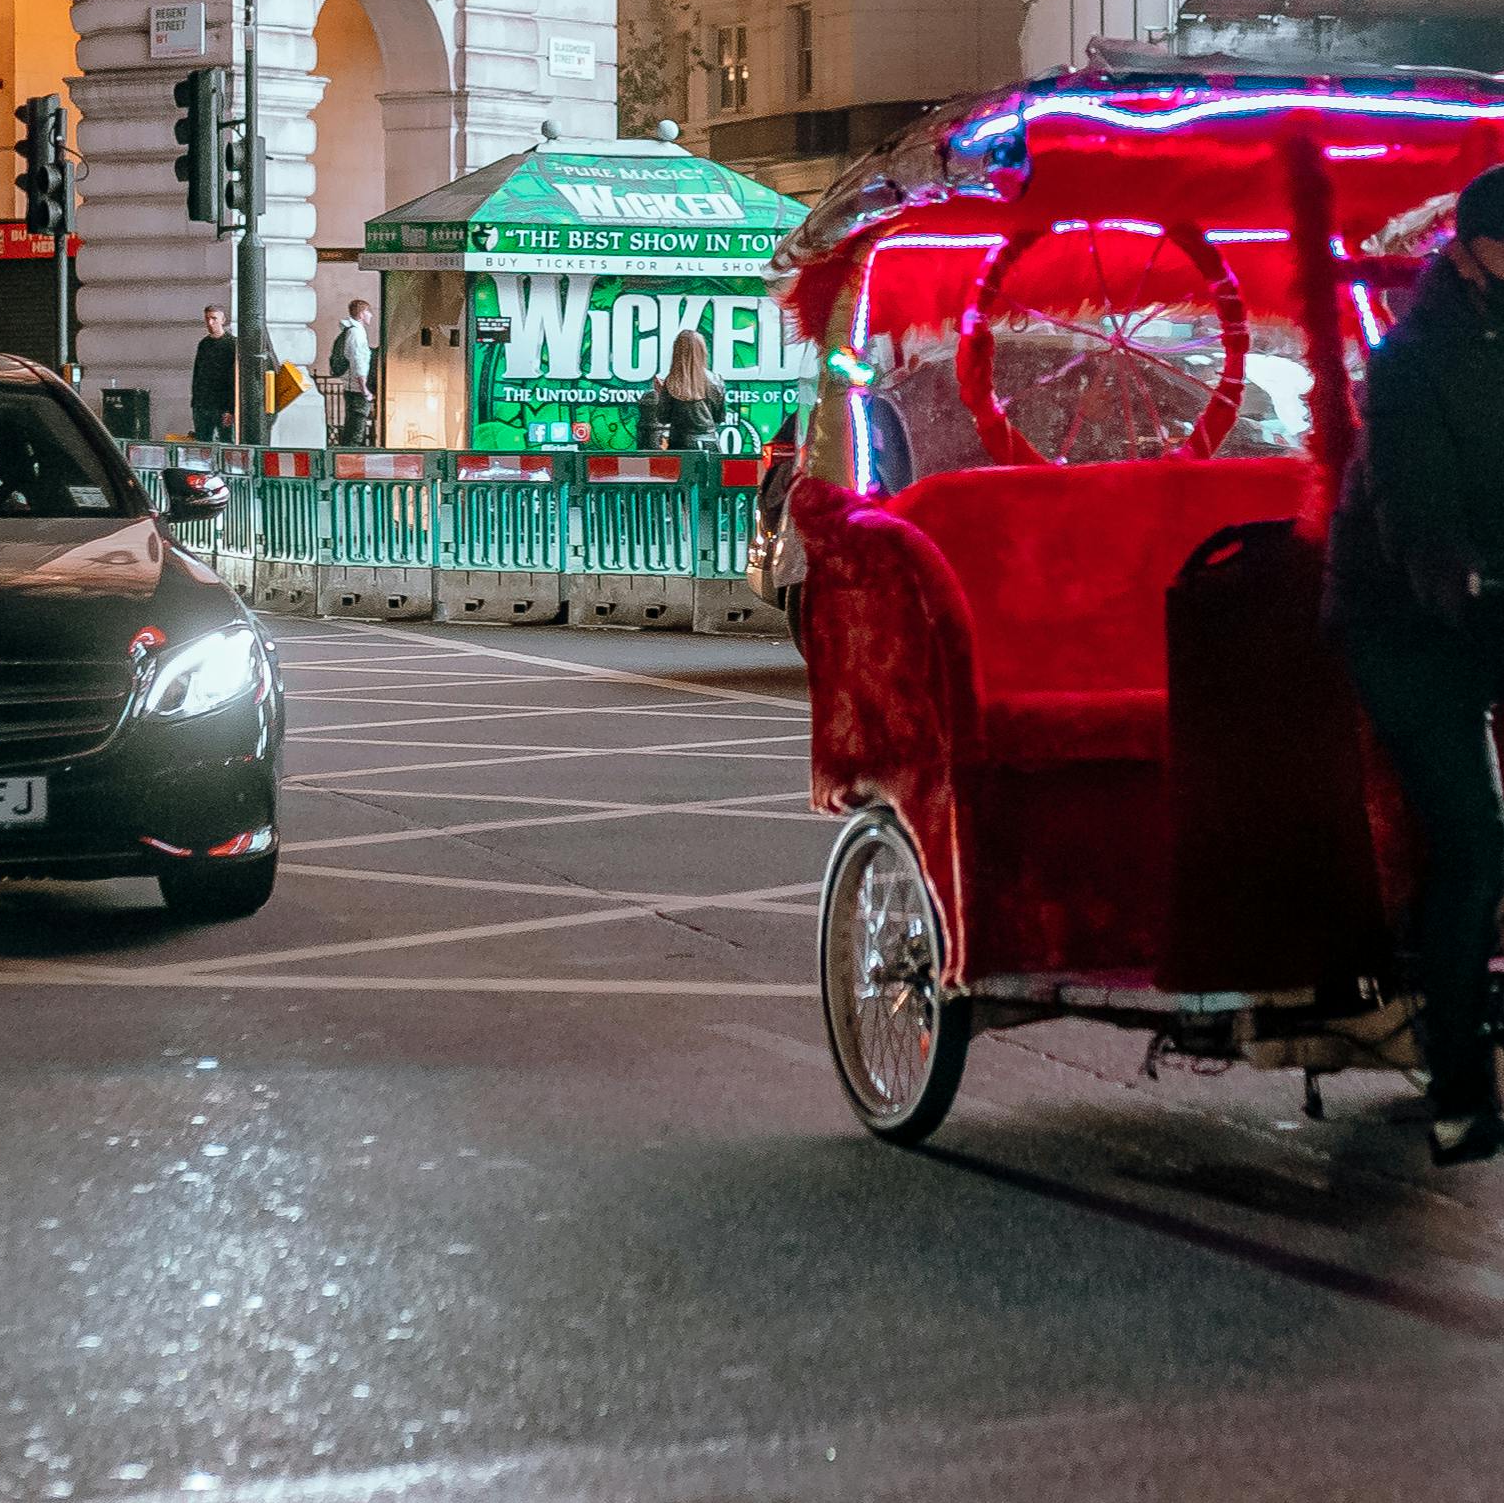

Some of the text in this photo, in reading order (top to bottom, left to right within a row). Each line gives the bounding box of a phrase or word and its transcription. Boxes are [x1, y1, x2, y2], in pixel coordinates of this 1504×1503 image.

[31, 240, 55, 253] HER
[568, 230, 623, 250] BEST
[629, 231, 699, 252] SHOW
[705, 233, 732, 252] IN
[485, 257, 518, 268] BUY
[537, 258, 608, 270] TICKETS
[625, 260, 658, 271] FOR
[675, 261, 705, 272] ALL
[503, 387, 532, 402] THE
[535, 388, 597, 403] UNTOLD
[724, 389, 760, 403] CHES
[762, 390, 782, 403] OF
[783, 389, 799, 404] O
